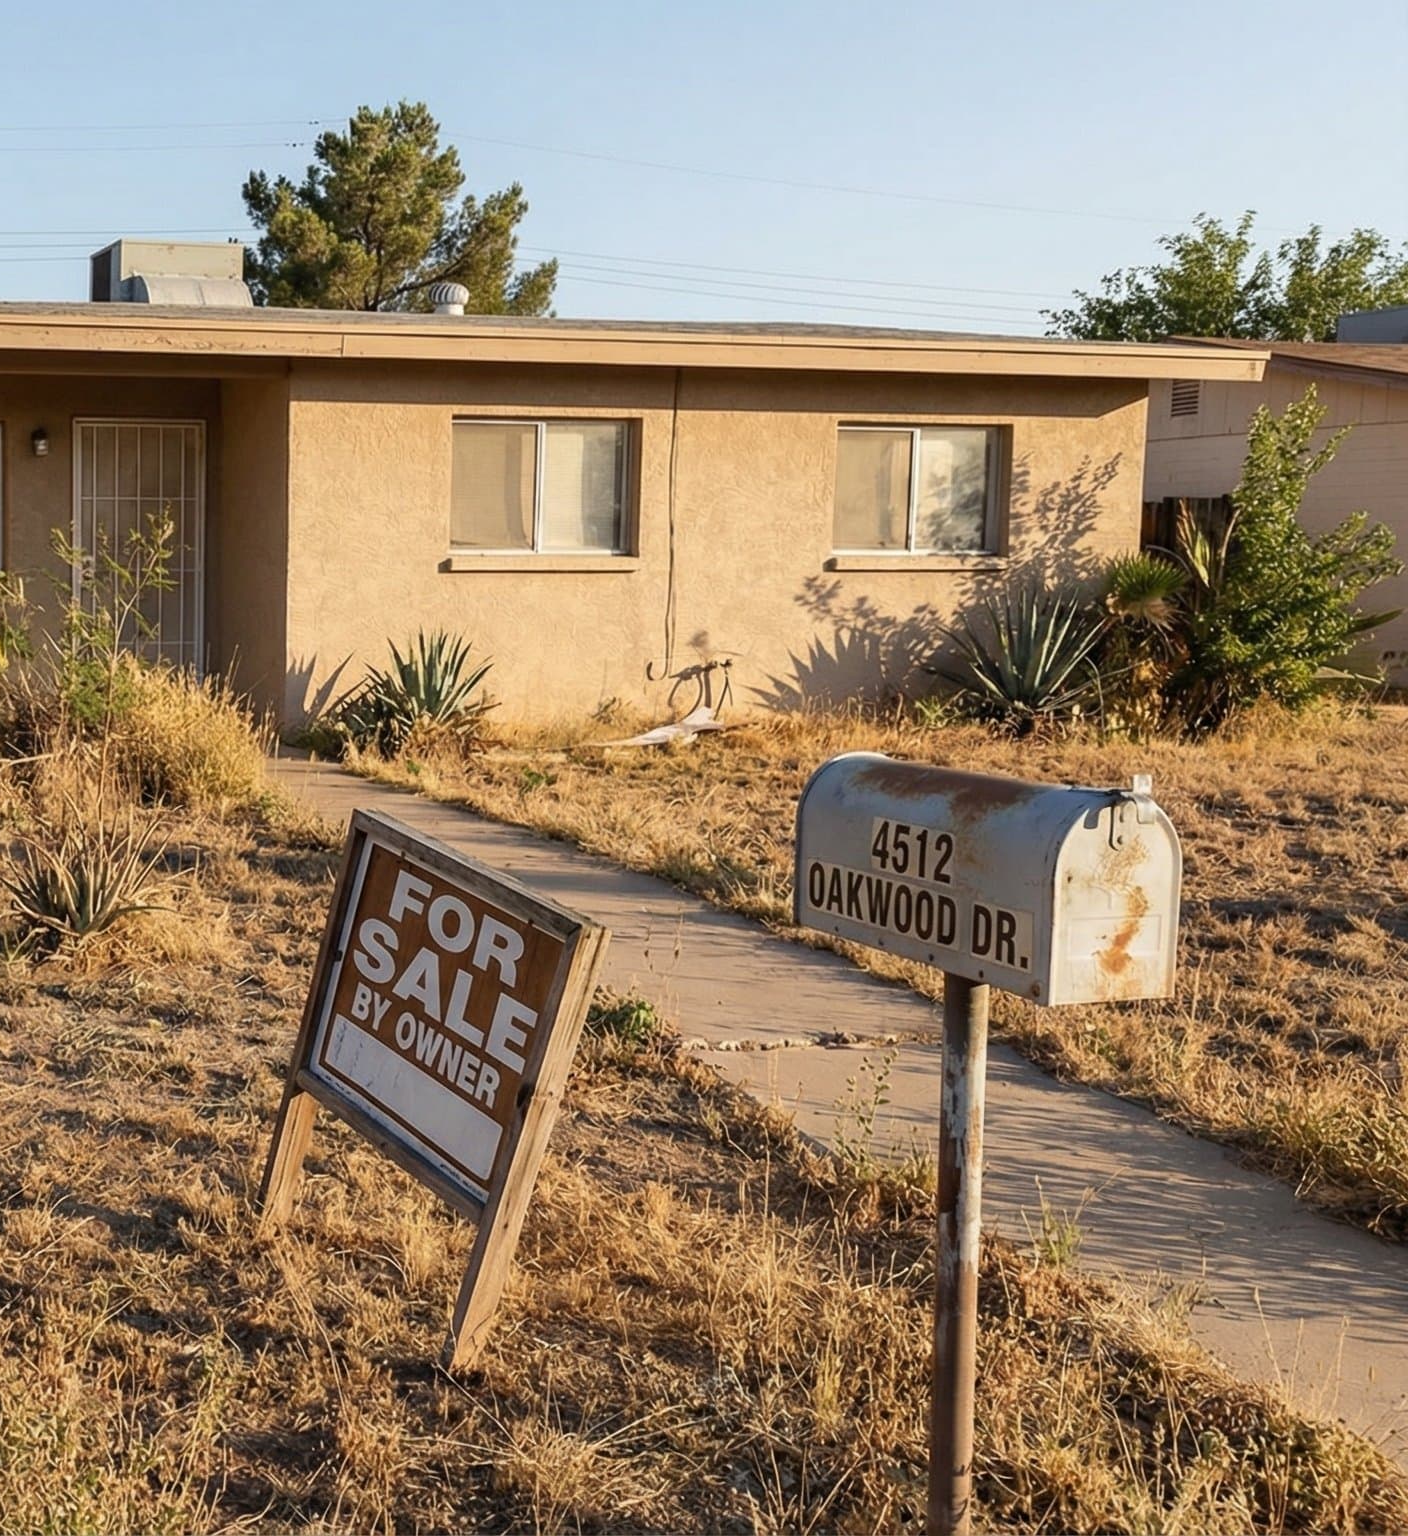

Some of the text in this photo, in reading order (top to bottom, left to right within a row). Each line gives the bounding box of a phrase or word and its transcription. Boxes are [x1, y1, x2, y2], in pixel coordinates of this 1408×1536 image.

[872, 821, 953, 884] 4512
[389, 870, 525, 988] FOR
[809, 862, 1029, 969] OAKWOOD DR.
[351, 983, 500, 1109] BY OWNER
[354, 919, 538, 1075] SALE
